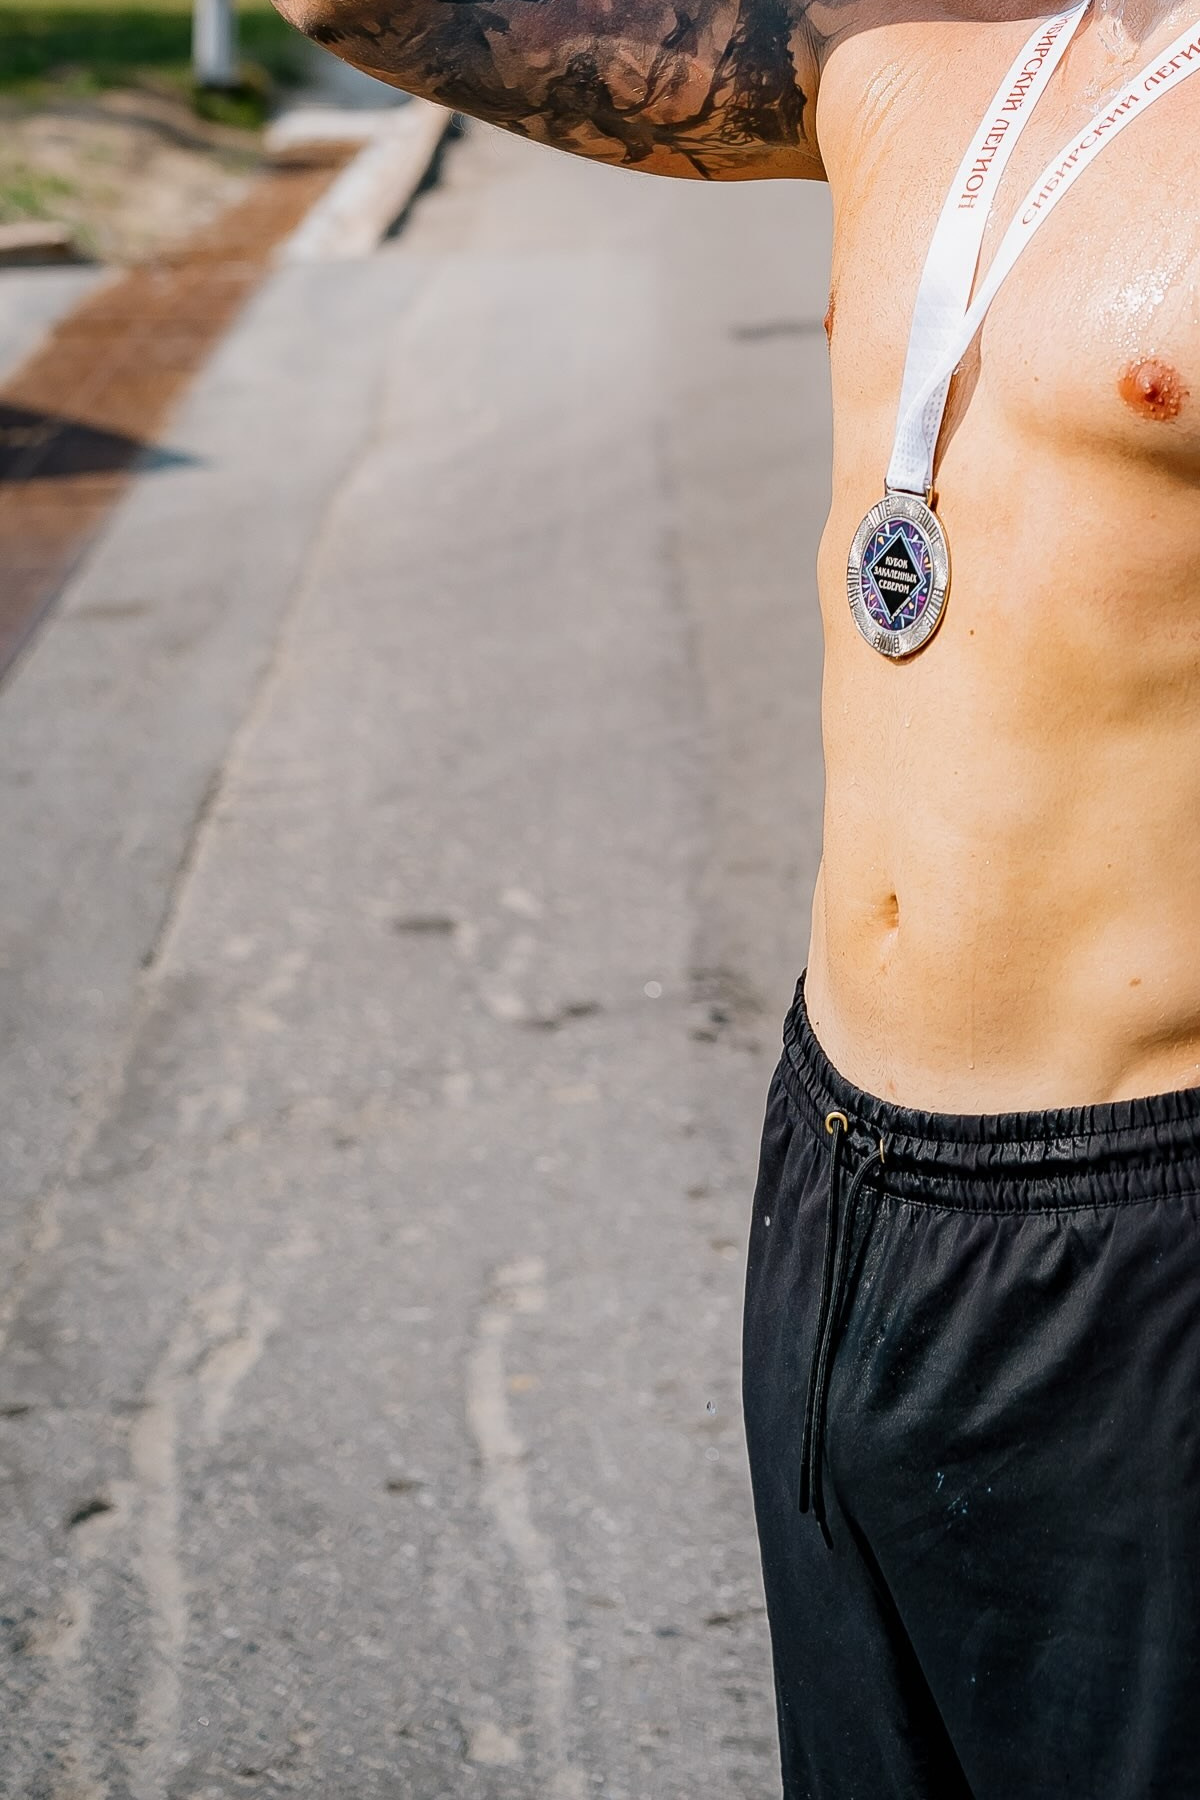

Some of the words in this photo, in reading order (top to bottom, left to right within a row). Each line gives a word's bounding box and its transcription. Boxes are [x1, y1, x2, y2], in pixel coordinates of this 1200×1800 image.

[1002, 16, 1073, 111] ИБИРСКИЙ
[958, 119, 1010, 208] ЛЕГИОН
[1022, 94, 1139, 225] СИБИРСКИЙ
[878, 579, 910, 594] СЕВЕРОМ
[885, 556, 908, 569] КУБОК
